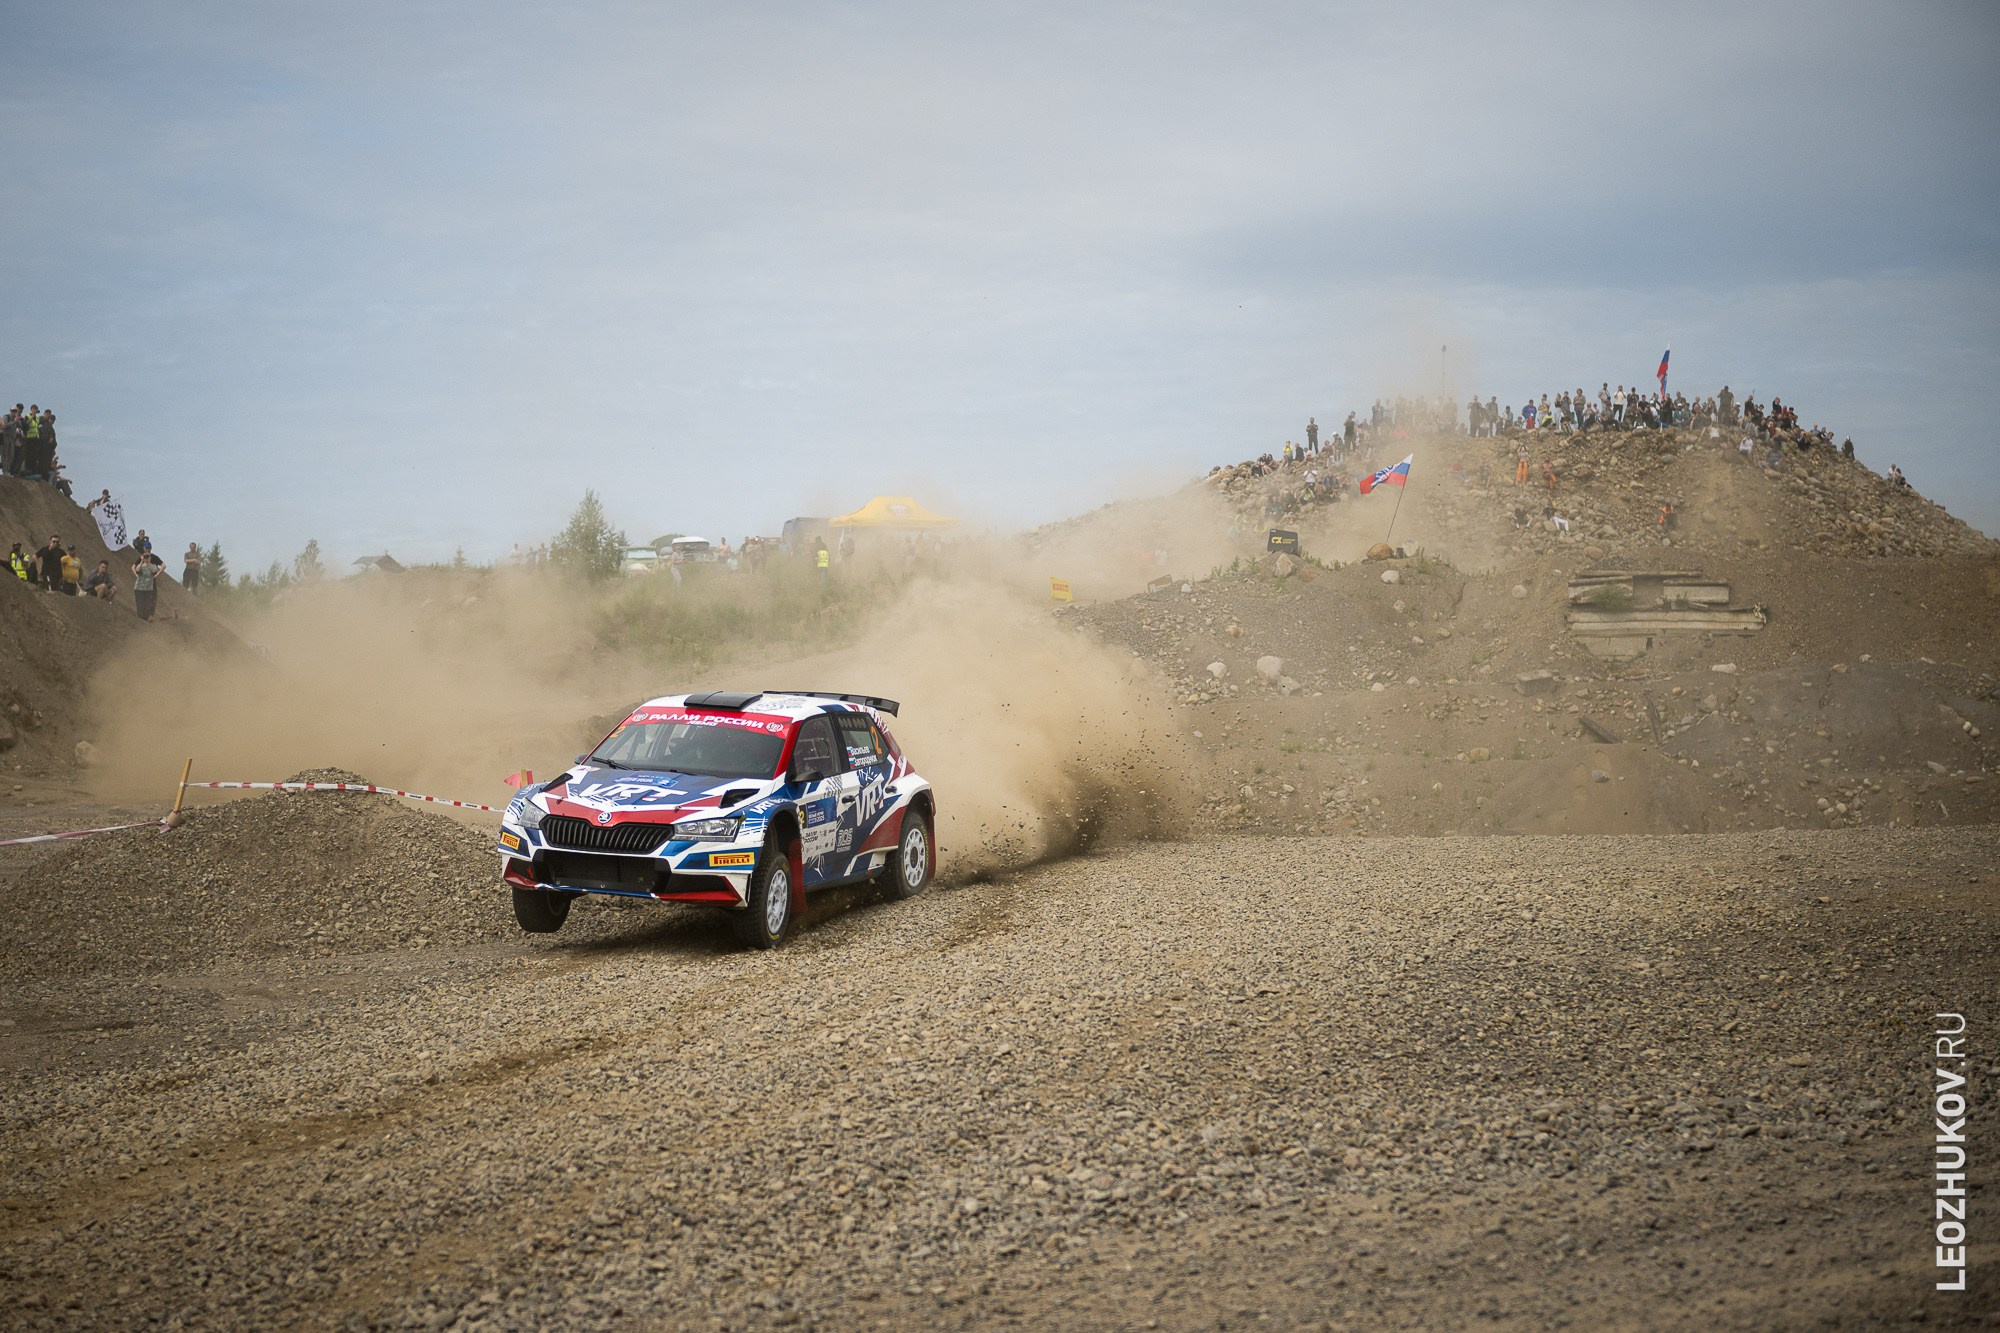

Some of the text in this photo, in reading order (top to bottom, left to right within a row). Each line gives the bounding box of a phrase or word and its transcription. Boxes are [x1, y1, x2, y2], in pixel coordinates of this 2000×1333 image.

[648, 713, 701, 722] РАЛЛИ
[704, 715, 765, 728] РОССИИ
[610, 725, 625, 738] 2
[870, 726, 883, 755] 2
[578, 783, 689, 798] VRT
[854, 772, 885, 827] VRT
[749, 800, 775, 815] VRT
[713, 854, 751, 865] PIRELLI
